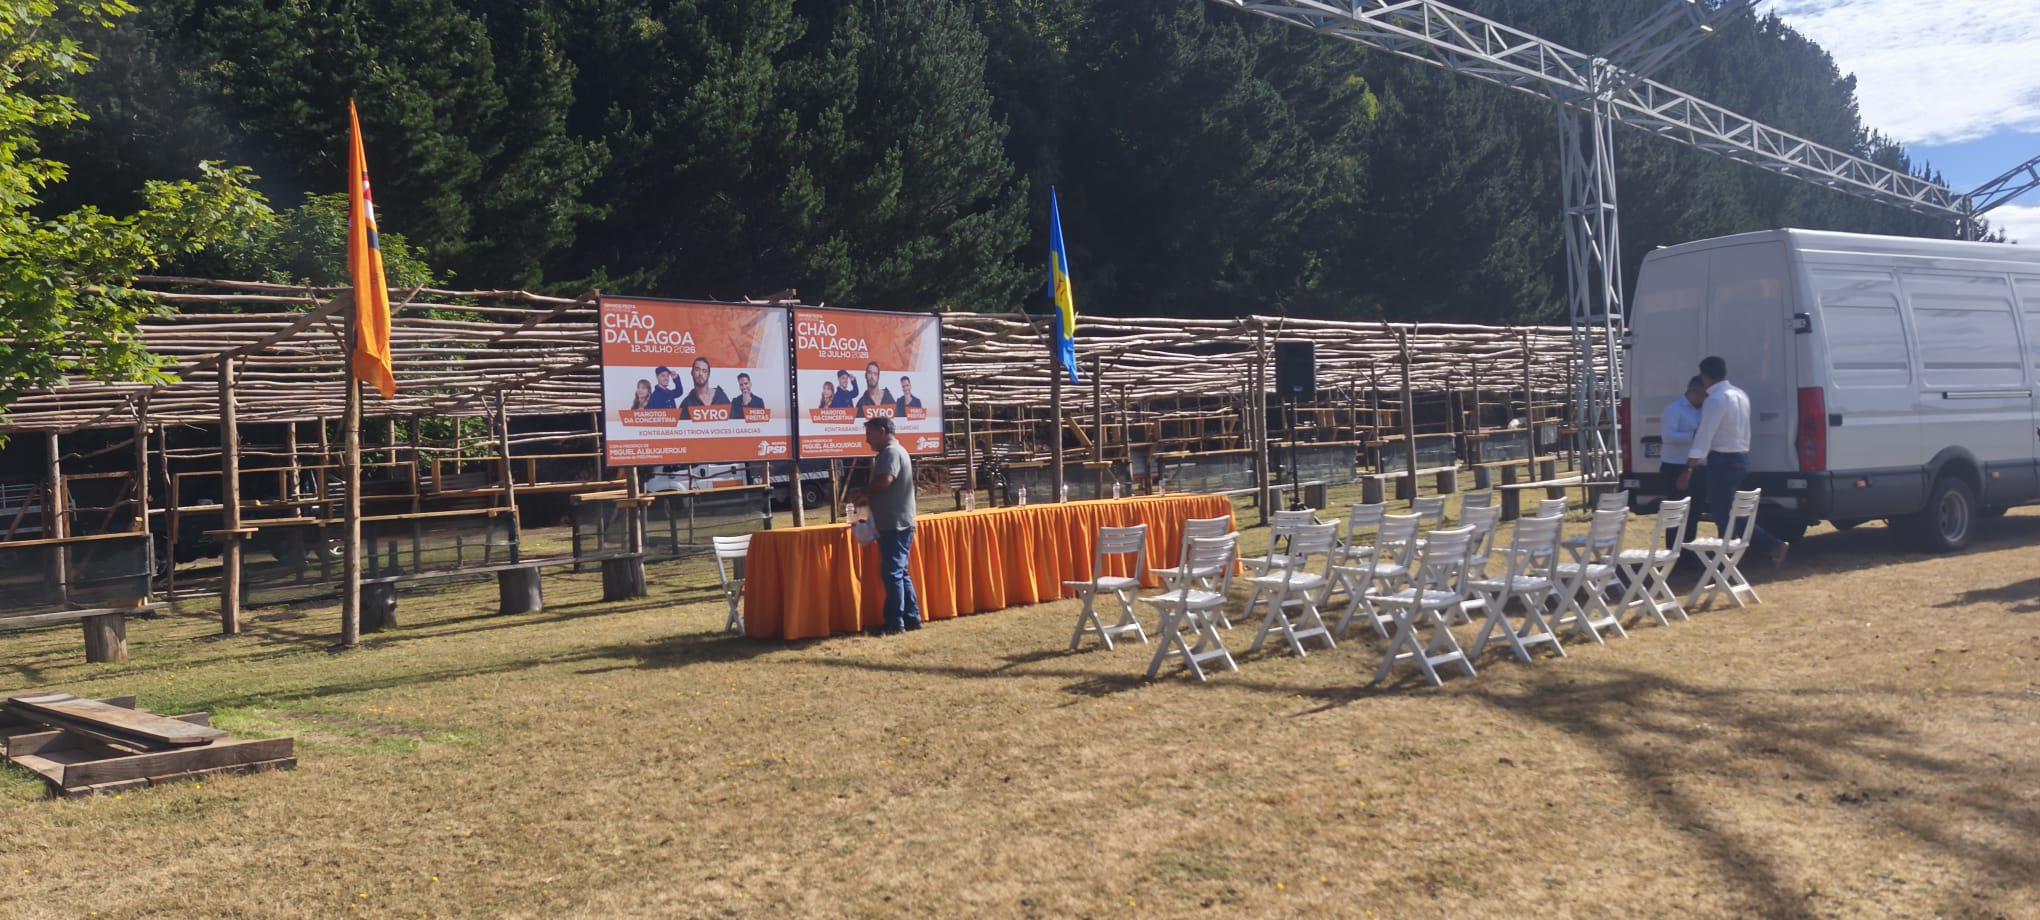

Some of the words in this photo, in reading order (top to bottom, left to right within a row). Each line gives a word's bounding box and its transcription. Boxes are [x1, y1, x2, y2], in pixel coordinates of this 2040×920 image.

[604, 311, 655, 329] CHÃO
[798, 320, 838, 337] CHÃO
[604, 329, 631, 344] DA
[633, 330, 694, 345] LAGOA
[798, 336, 819, 350] DA
[820, 337, 868, 351] LAGOA
[631, 345, 641, 353] 12
[641, 345, 673, 354] JULHO
[673, 346, 696, 354] 2026
[818, 350, 827, 358] 12
[827, 351, 851, 359] JULHO
[693, 408, 728, 421] SYRO
[866, 408, 894, 418] SYRO
[766, 446, 787, 454] PSD
[924, 441, 940, 449] PSD
[609, 448, 635, 456] MIGUEL
[636, 446, 688, 455] ALBUQUERQUE
